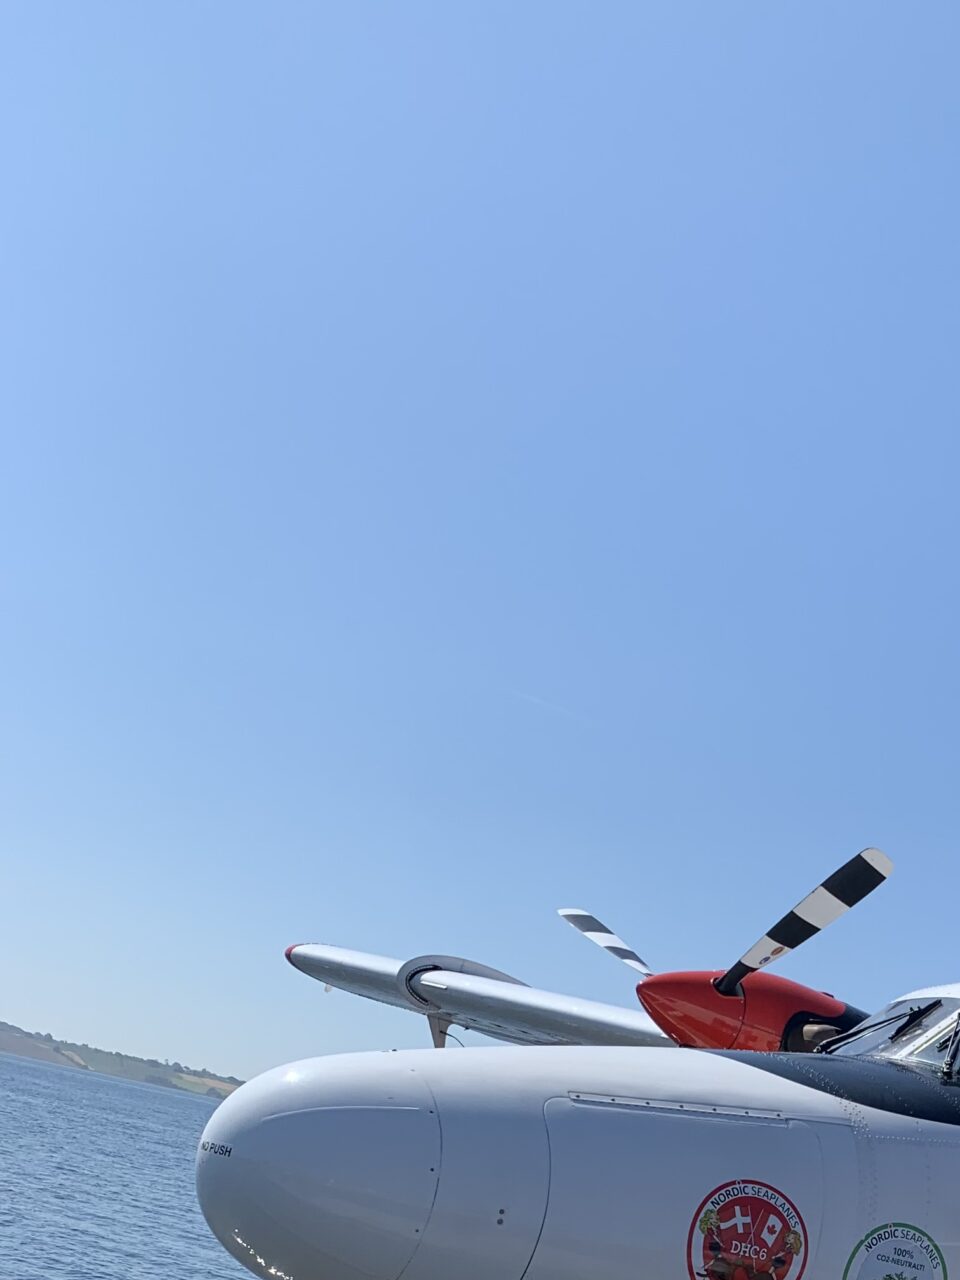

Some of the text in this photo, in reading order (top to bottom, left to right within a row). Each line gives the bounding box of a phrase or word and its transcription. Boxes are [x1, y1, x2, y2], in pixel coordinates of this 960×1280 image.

[209, 1142, 232, 1157] PUSH
[710, 1183, 800, 1229] NORDIC SEAPLANES
[730, 1240, 768, 1261] DHC6
[864, 1229, 941, 1270] NORDIC SEAPLANES
[893, 1247, 914, 1259] 100%
